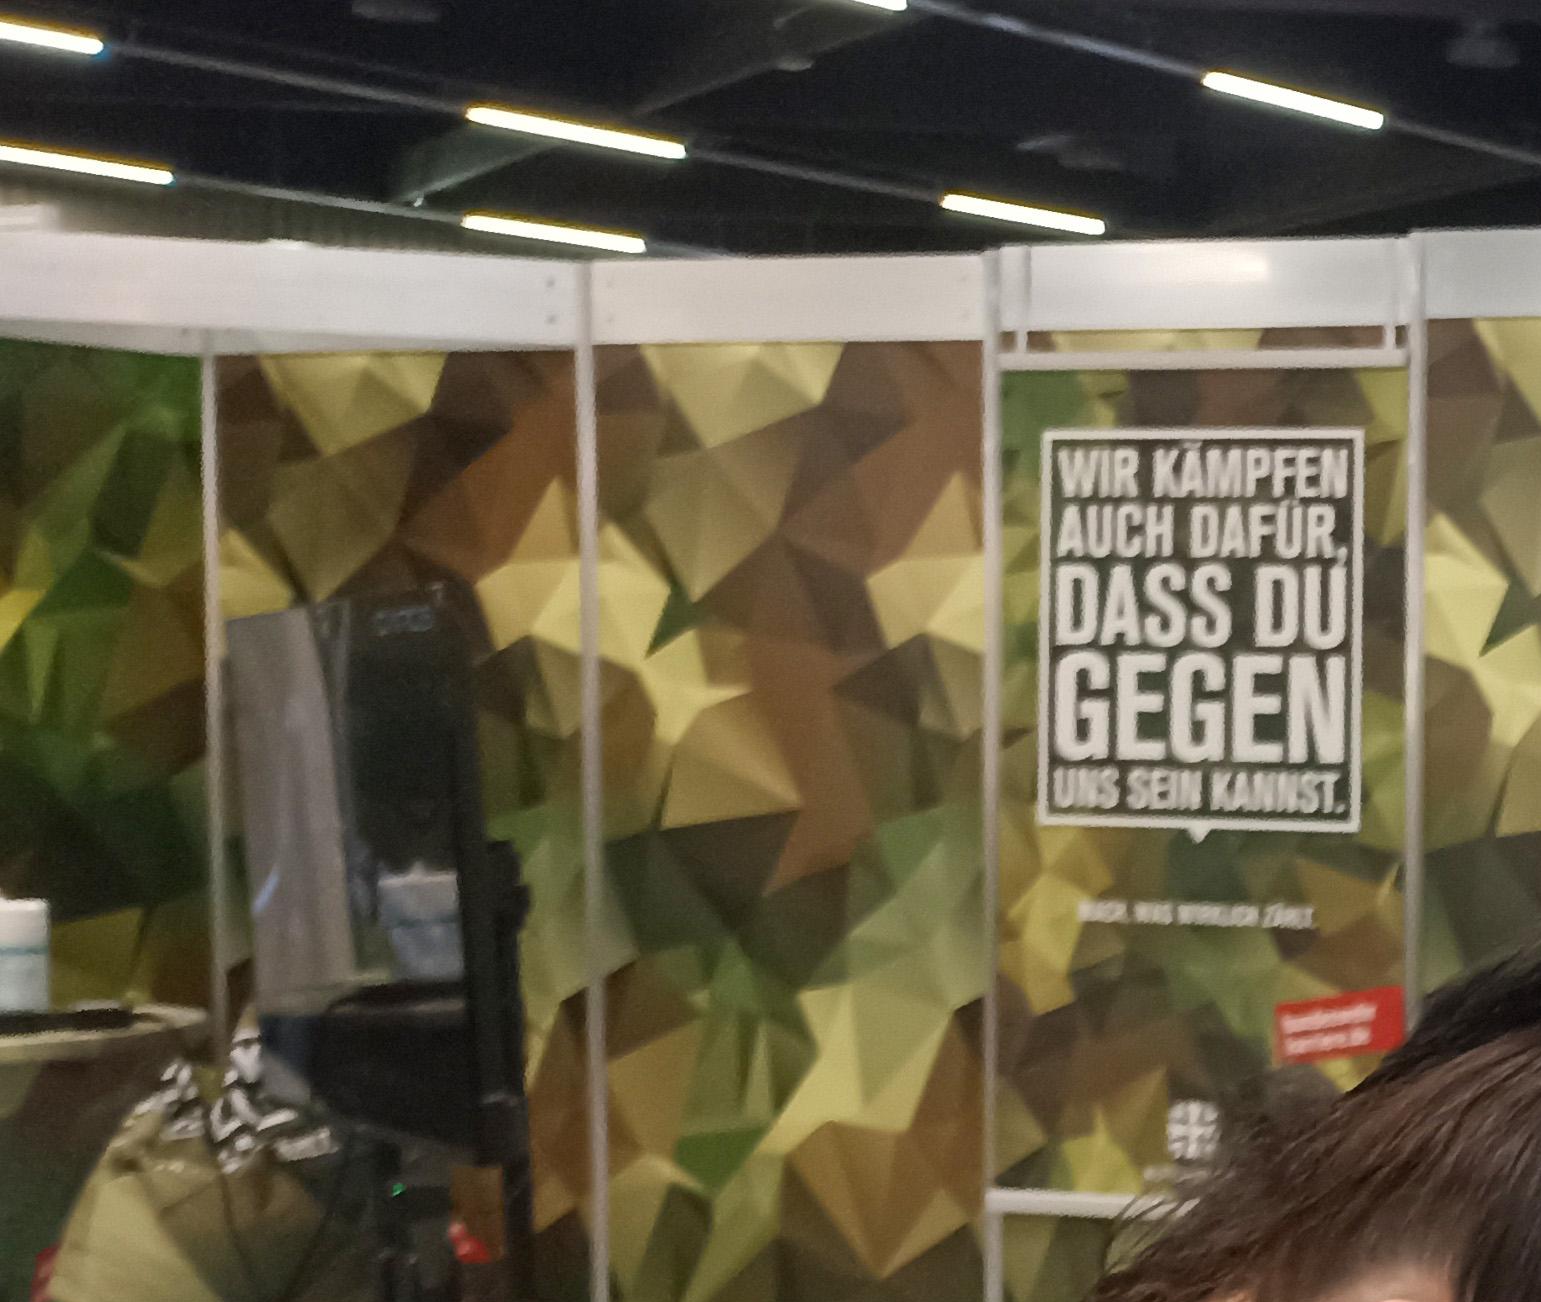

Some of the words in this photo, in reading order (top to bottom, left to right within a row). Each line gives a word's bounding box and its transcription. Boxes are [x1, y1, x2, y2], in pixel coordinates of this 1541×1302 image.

[1057, 447, 1140, 499] WIR
[1152, 441, 1349, 500] KÄMPFEN
[1056, 503, 1175, 558] AUCH
[1189, 499, 1348, 563] DAFÜR,
[1054, 562, 1233, 648] DASS
[1254, 563, 1347, 650] DU
[1054, 651, 1346, 764] GEGEN
[1053, 766, 1120, 810] UNS
[1126, 767, 1203, 811] SEIN
[1210, 770, 1346, 815] KANNST.
